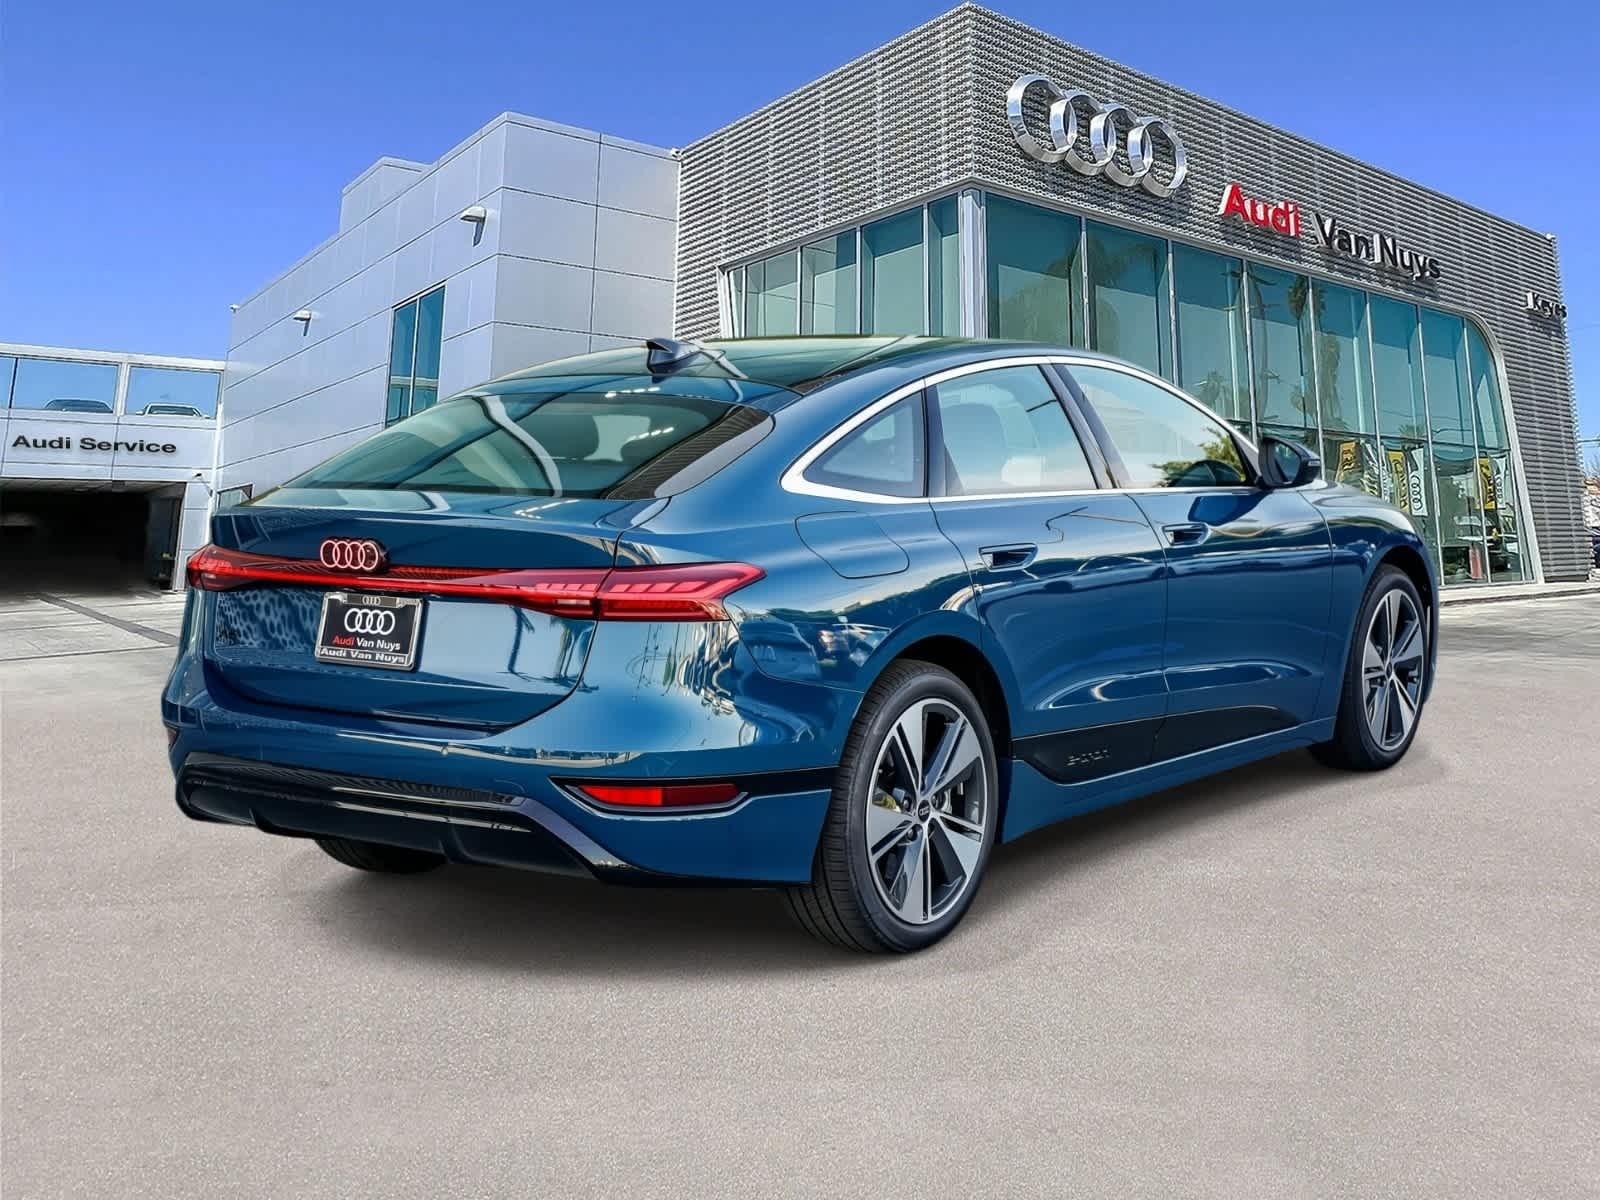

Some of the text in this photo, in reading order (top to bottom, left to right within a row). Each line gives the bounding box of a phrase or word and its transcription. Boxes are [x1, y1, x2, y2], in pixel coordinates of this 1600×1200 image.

[1219, 182, 1441, 281] Audi Van Nuys
[12, 435, 177, 454] Audi Service
[332, 634, 401, 652] Audi Van Nuys
[320, 647, 406, 665] Audi Van Nuys
